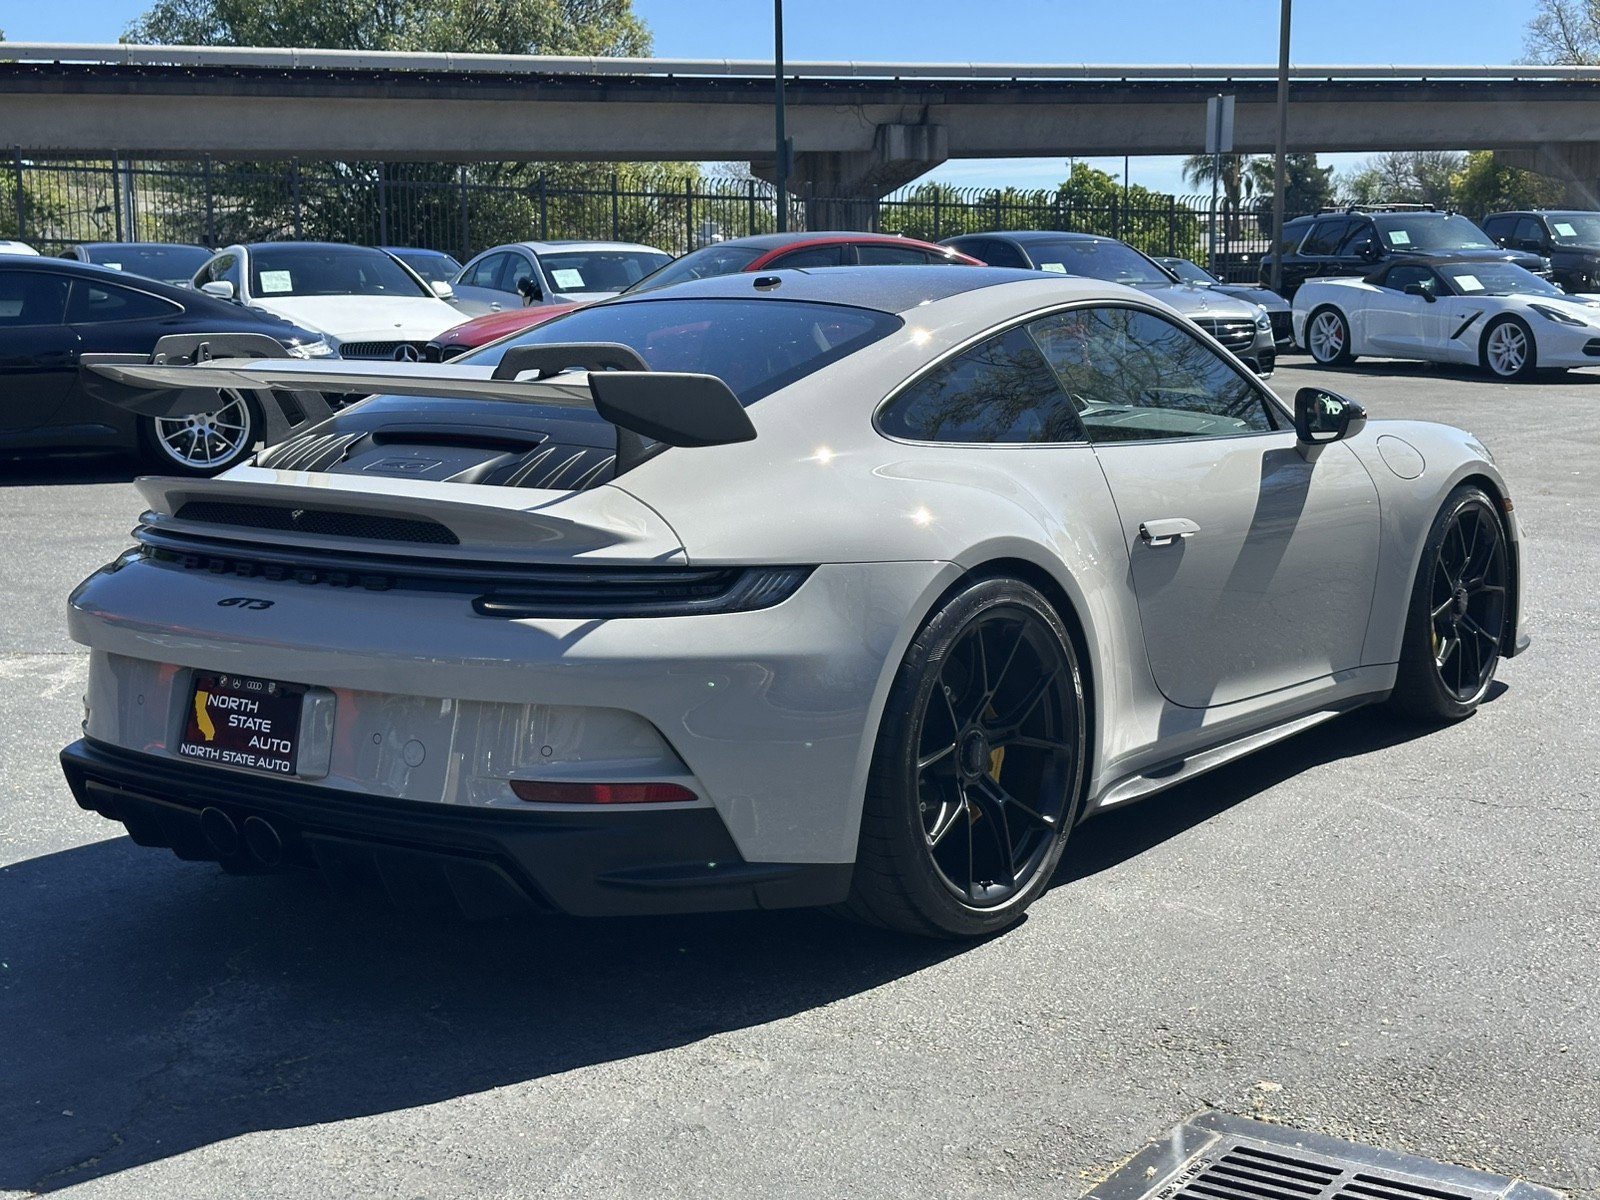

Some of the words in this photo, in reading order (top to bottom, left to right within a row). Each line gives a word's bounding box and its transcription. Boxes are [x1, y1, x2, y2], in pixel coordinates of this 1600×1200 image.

[217, 597, 276, 610] GT3
[207, 694, 259, 713] NORTH
[228, 714, 272, 733] STATE
[248, 735, 291, 753] AUTO
[180, 743, 220, 760] NORTH
[222, 750, 255, 766] STATE
[256, 756, 290, 772] AUTO
